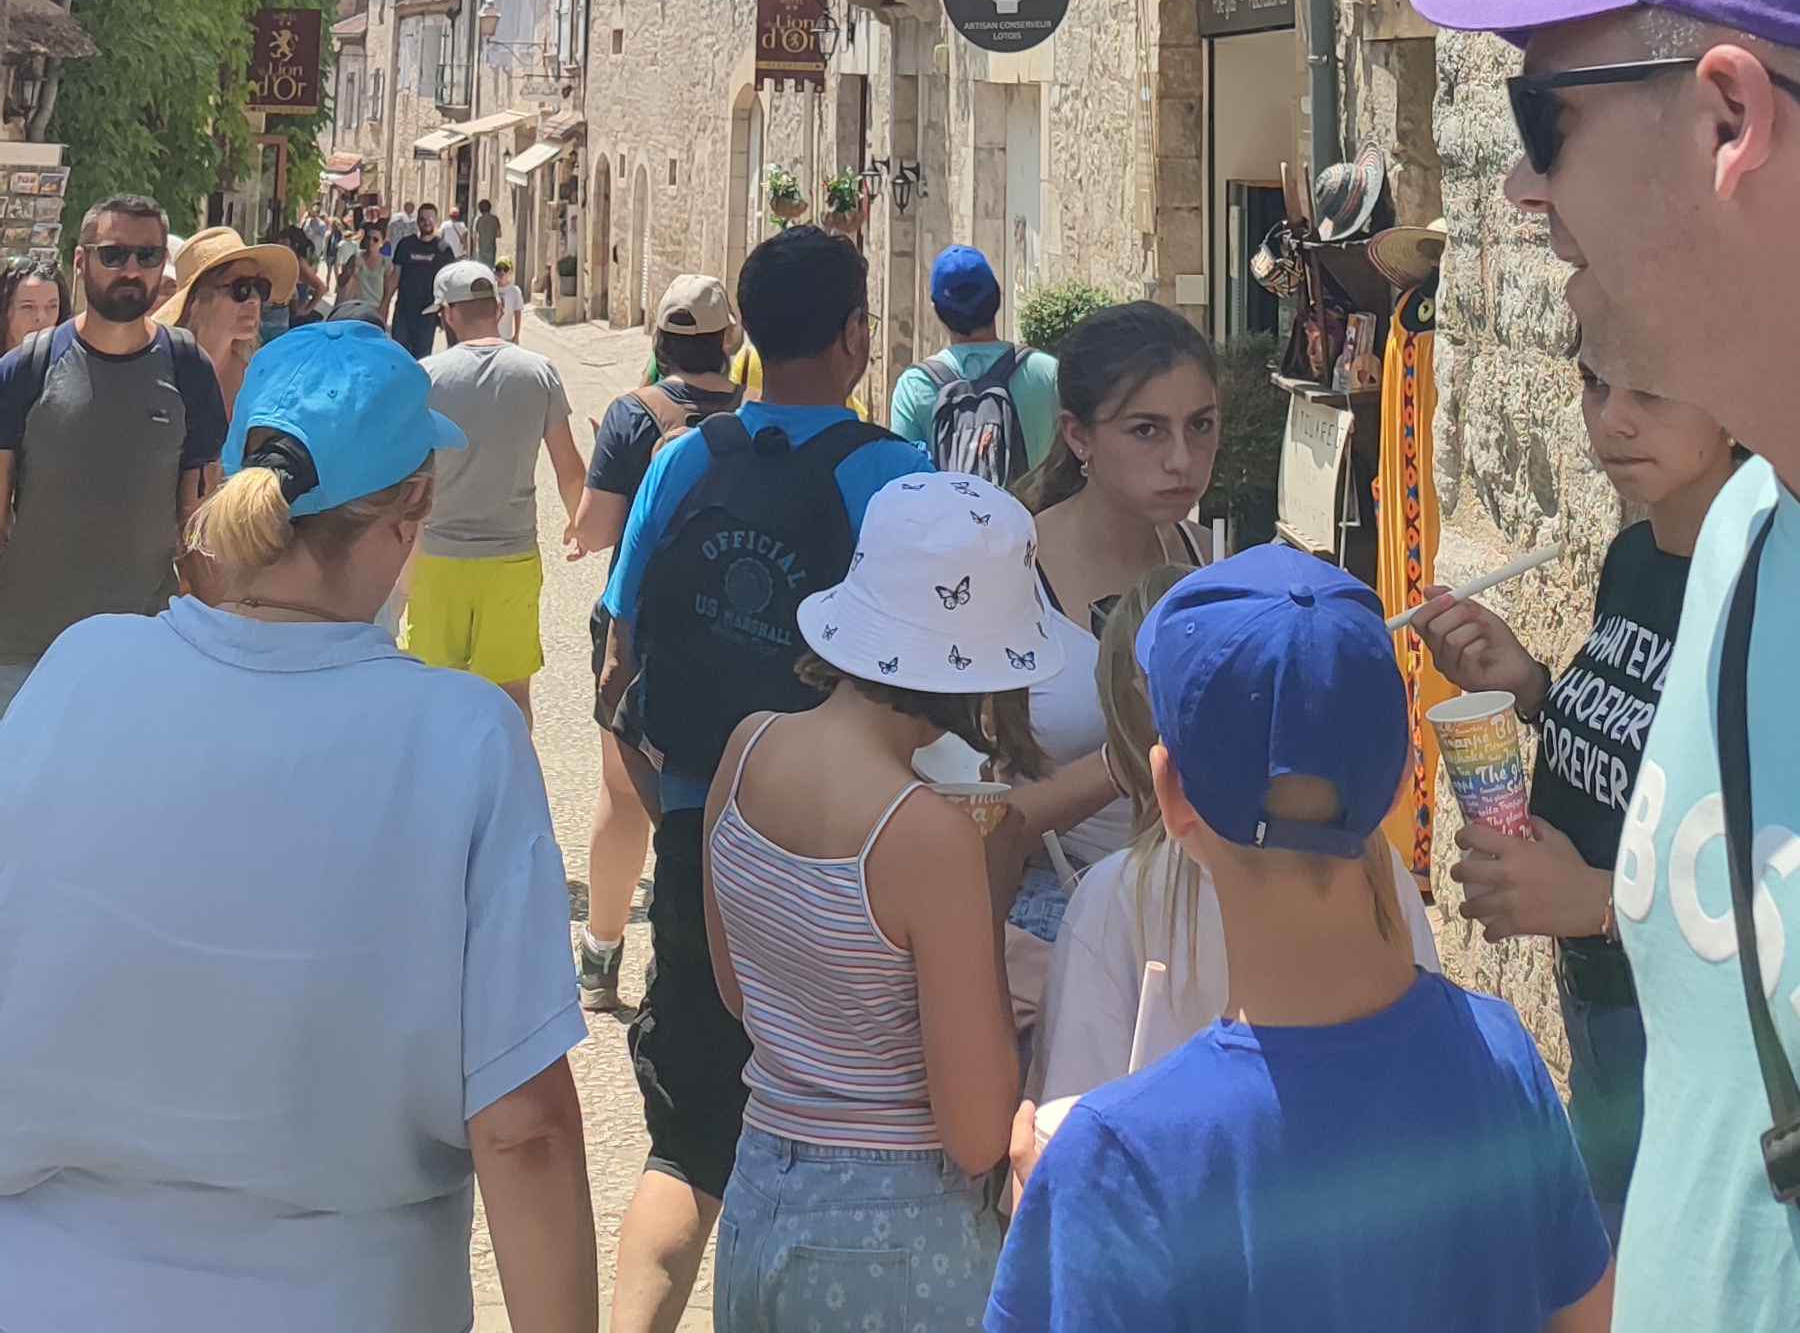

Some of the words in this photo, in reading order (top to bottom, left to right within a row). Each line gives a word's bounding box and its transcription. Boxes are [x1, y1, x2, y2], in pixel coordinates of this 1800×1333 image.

[776, 14, 815, 30] Lion
[964, 22, 998, 31] ARTISAN
[999, 20, 1052, 30] CONSERVEUR
[993, 32, 1022, 41] LOTOIS
[268, 62, 303, 76] Lion
[257, 75, 307, 100] d'Or
[702, 530, 807, 589] OFFICIAL
[724, 610, 792, 646] MARSHALL
[1539, 710, 1630, 813] OREVER
